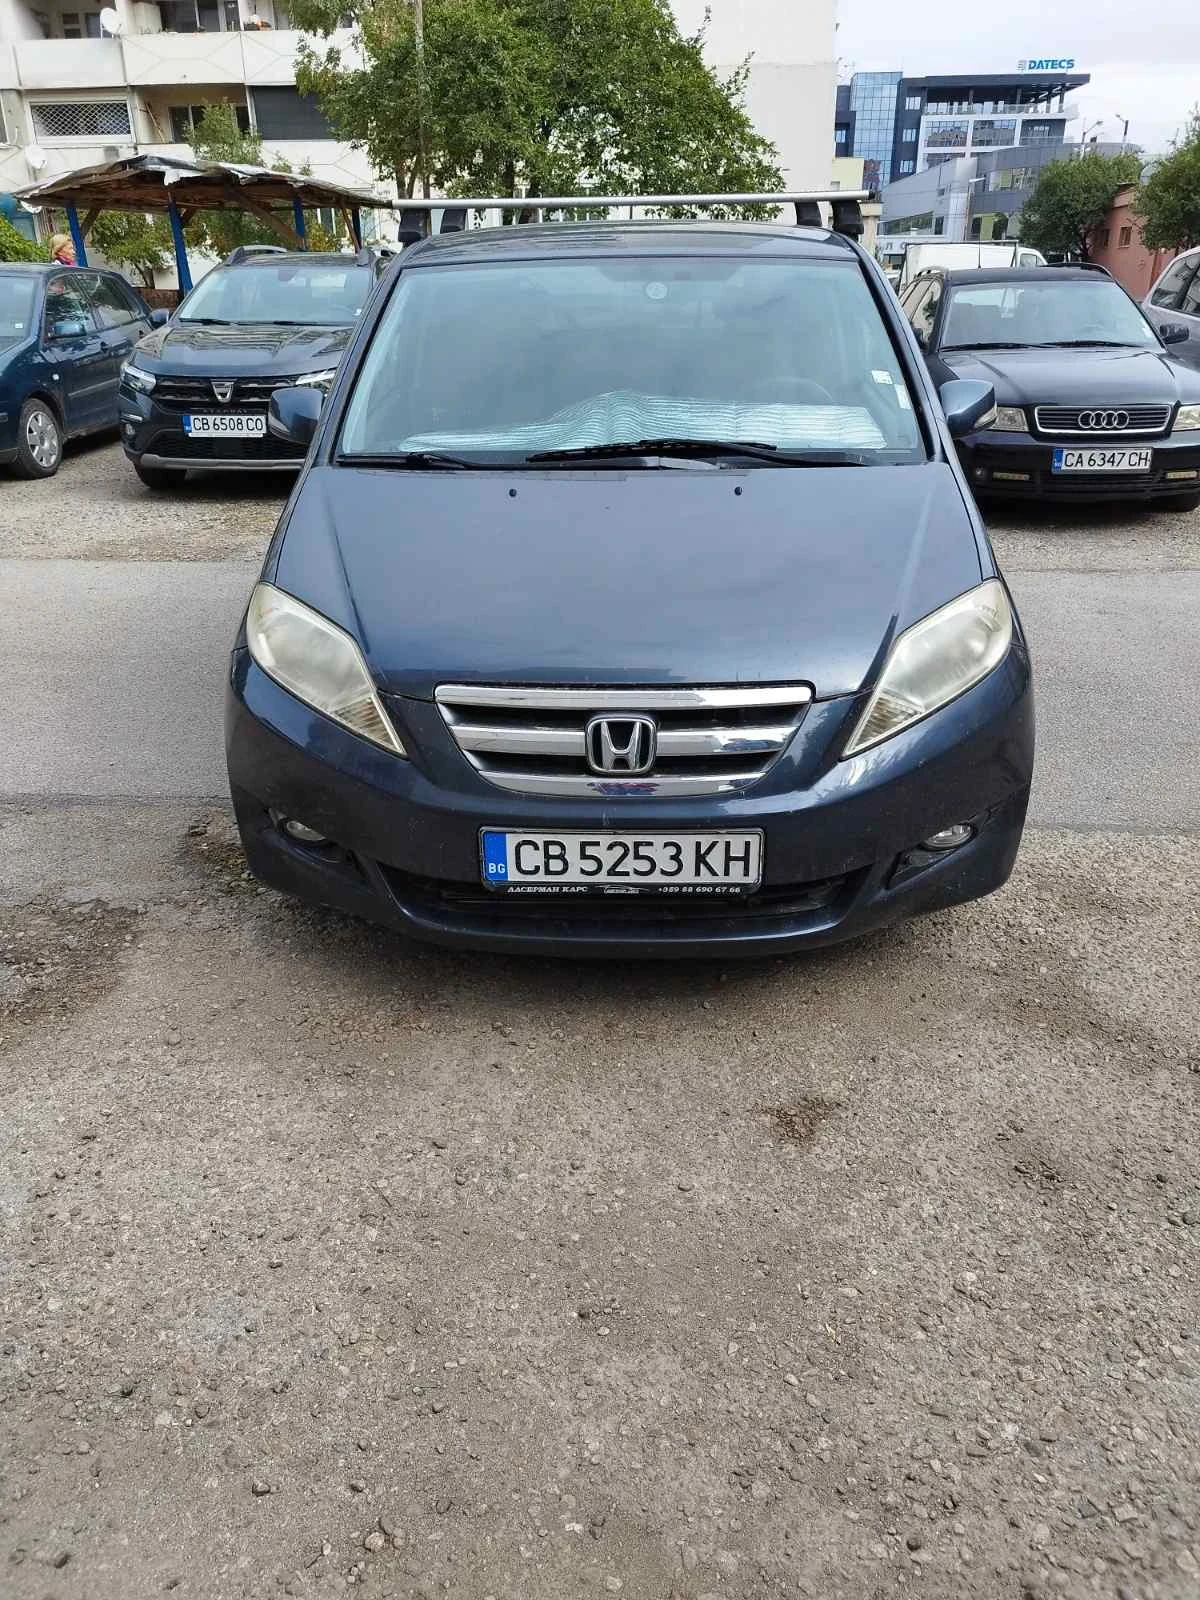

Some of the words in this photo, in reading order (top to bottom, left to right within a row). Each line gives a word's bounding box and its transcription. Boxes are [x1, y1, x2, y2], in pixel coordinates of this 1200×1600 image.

[1028, 59, 1075, 70] DATECS
[193, 417, 210, 431] CB
[213, 417, 244, 431] 6508
[246, 417, 264, 431] CO
[1064, 452, 1084, 467] CA
[1087, 452, 1126, 467] 6347
[1128, 451, 1149, 467] CH
[514, 839, 569, 876] CB
[579, 840, 684, 877] 5253
[694, 840, 751, 877] KH
[488, 862, 506, 874] BG
